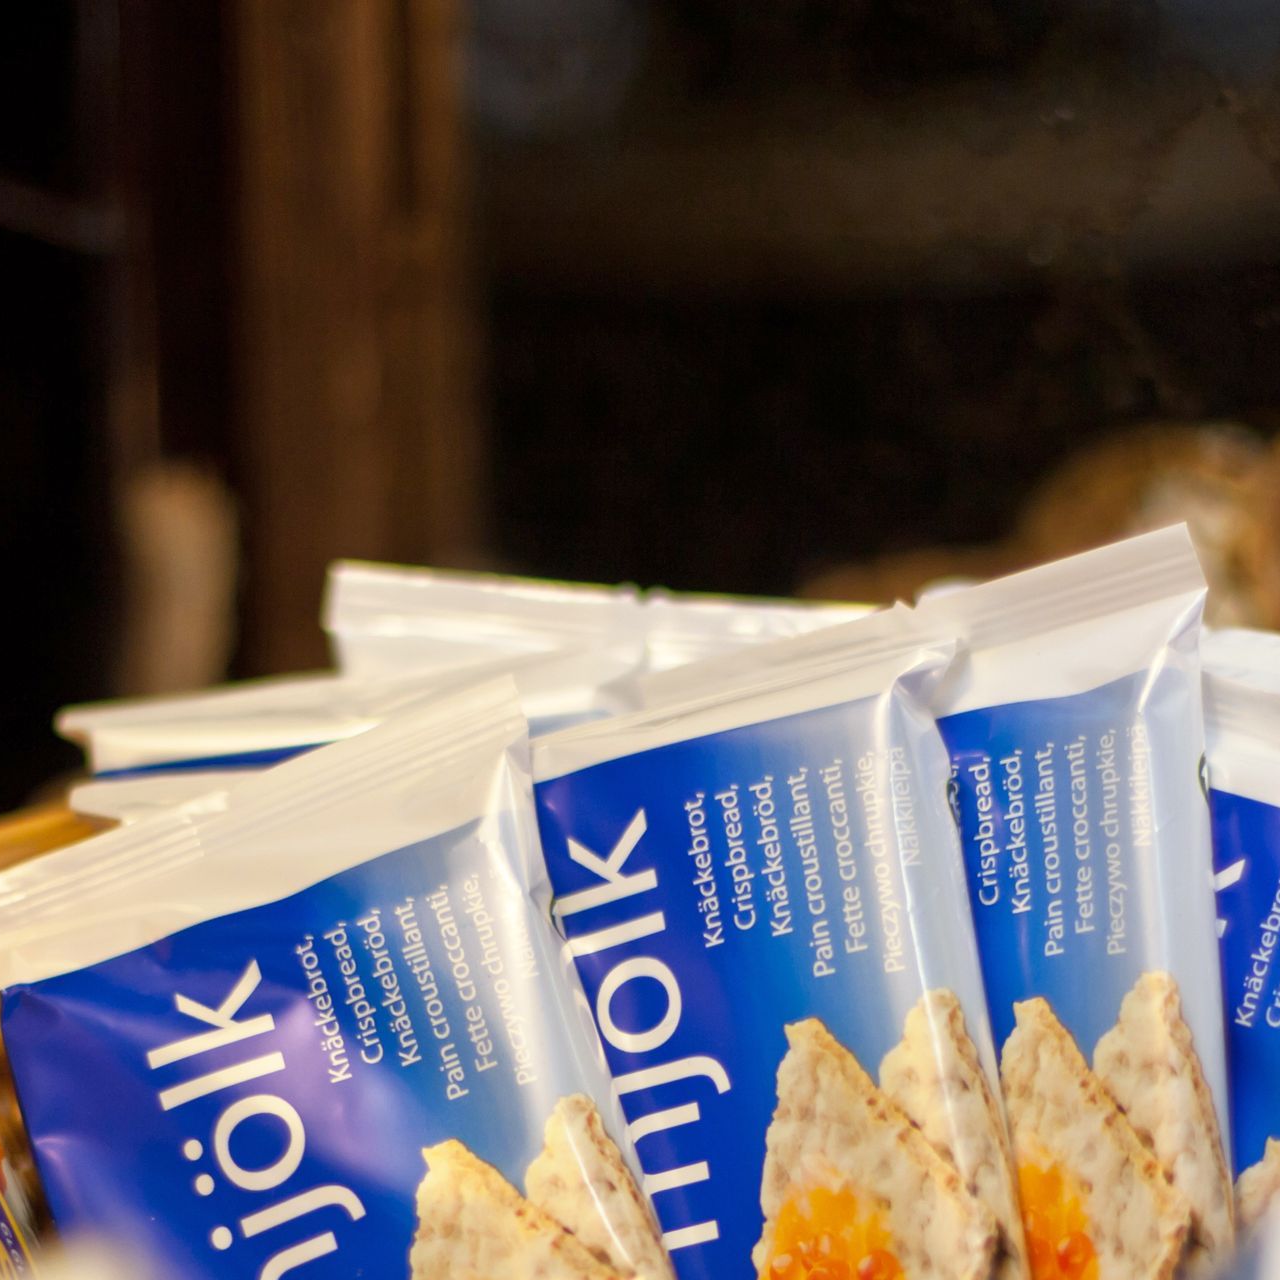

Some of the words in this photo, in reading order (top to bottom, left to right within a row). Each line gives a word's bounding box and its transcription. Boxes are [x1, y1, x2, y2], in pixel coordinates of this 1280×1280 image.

[787, 767, 826, 915] croustillant,
[820, 758, 857, 881] croccanti,
[855, 750, 887, 858] chrupkie,
[968, 757, 1000, 906] Crispbread,
[1000, 748, 1031, 914] Knäckebröd,
[1034, 742, 1062, 894] croustillant,
[1064, 735, 1090, 861] croccanti,
[1096, 728, 1121, 838] chrupkie,
[684, 792, 724, 948] Knäckebrot,
[715, 784, 756, 930] Crispbread,
[749, 775, 793, 937] Knäckebröd,
[1075, 866, 1095, 934] Fette
[1106, 843, 1128, 956] Pieczywo
[395, 897, 450, 1039] croustillant,
[426, 885, 475, 1001] croccanti,
[462, 872, 503, 975] chrupkie,
[810, 921, 835, 977] Pain
[842, 886, 868, 953] Fette
[873, 865, 905, 973] Pieczywo
[1044, 900, 1064, 957] Pain
[296, 934, 352, 1083] Knäckebrot,
[324, 921, 383, 1064] Crispbread,
[357, 908, 421, 1066] Knäckebröd,
[466, 1006, 498, 1072] Fette
[440, 1044, 469, 1100] Pain
